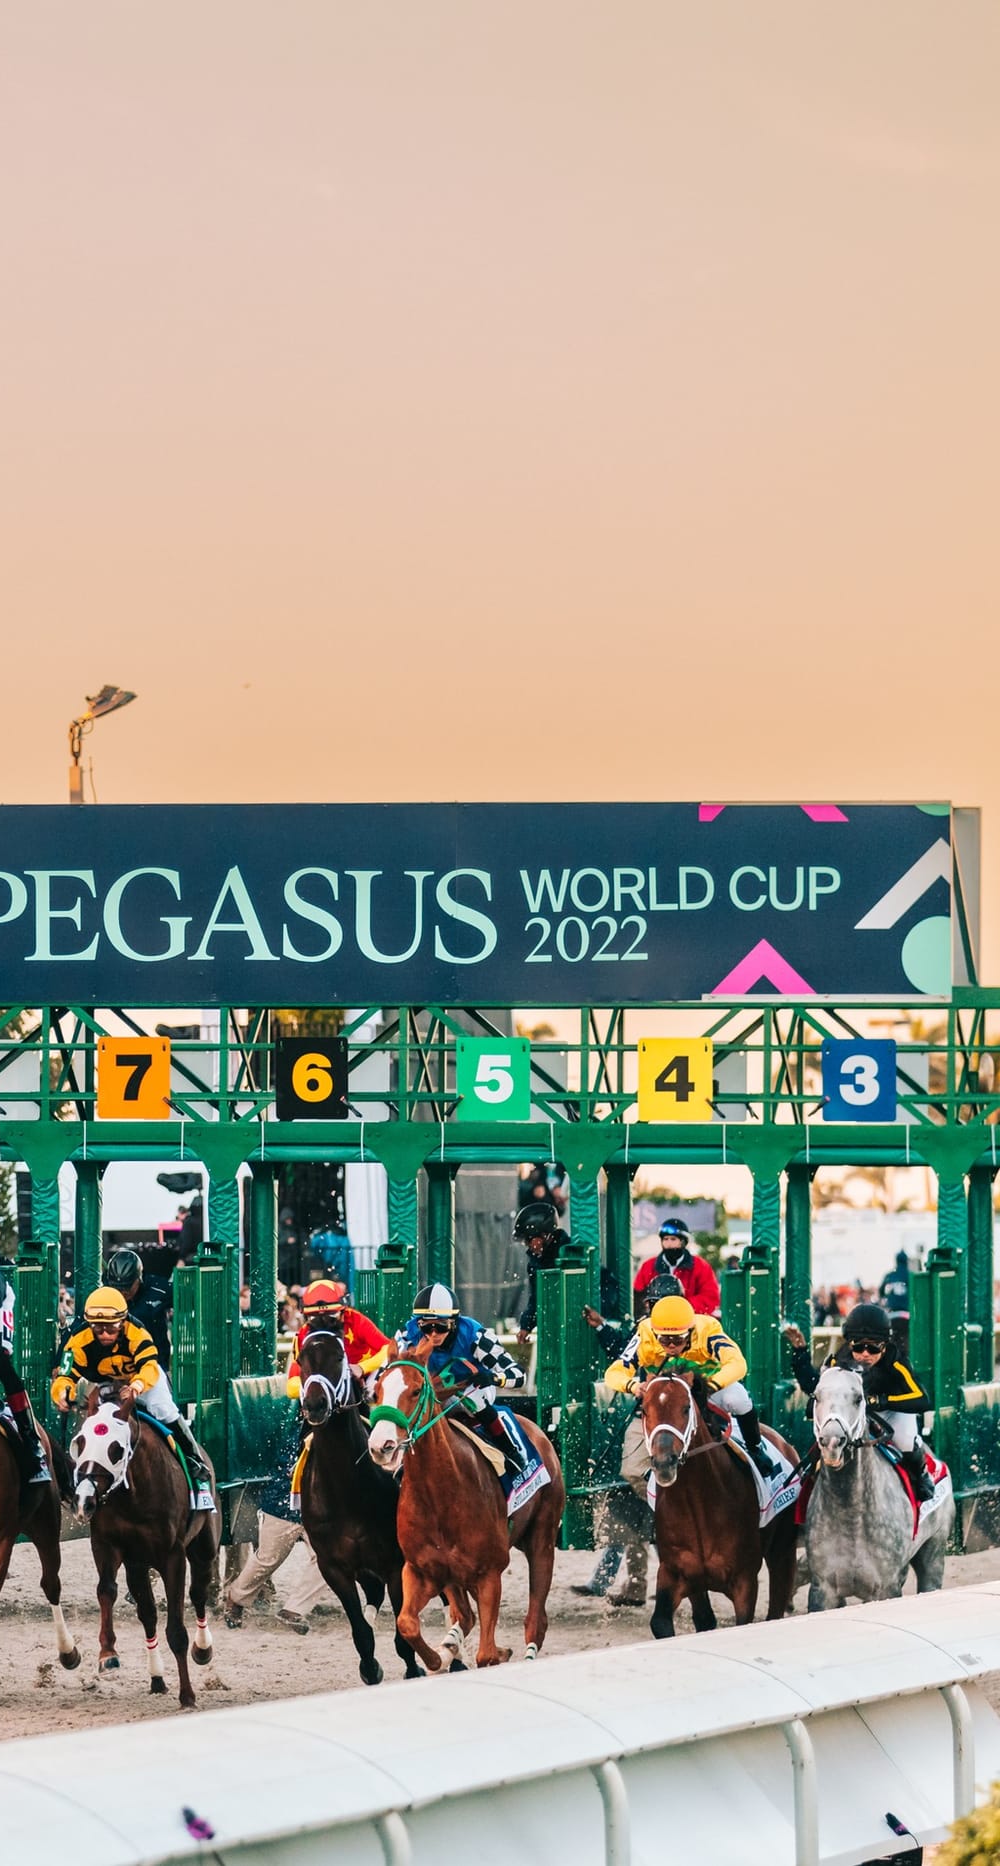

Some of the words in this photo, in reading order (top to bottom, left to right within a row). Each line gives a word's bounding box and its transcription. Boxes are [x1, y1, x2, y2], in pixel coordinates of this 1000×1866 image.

[519, 865, 715, 912] WORLD
[728, 865, 842, 912] CUP
[523, 914, 649, 963] 2022
[115, 1054, 153, 1101] 7
[291, 1052, 334, 1103] 6
[473, 1054, 514, 1104] 5
[654, 1055, 696, 1102] 4
[839, 1054, 880, 1106] 3
[60, 1352, 72, 1375] 5
